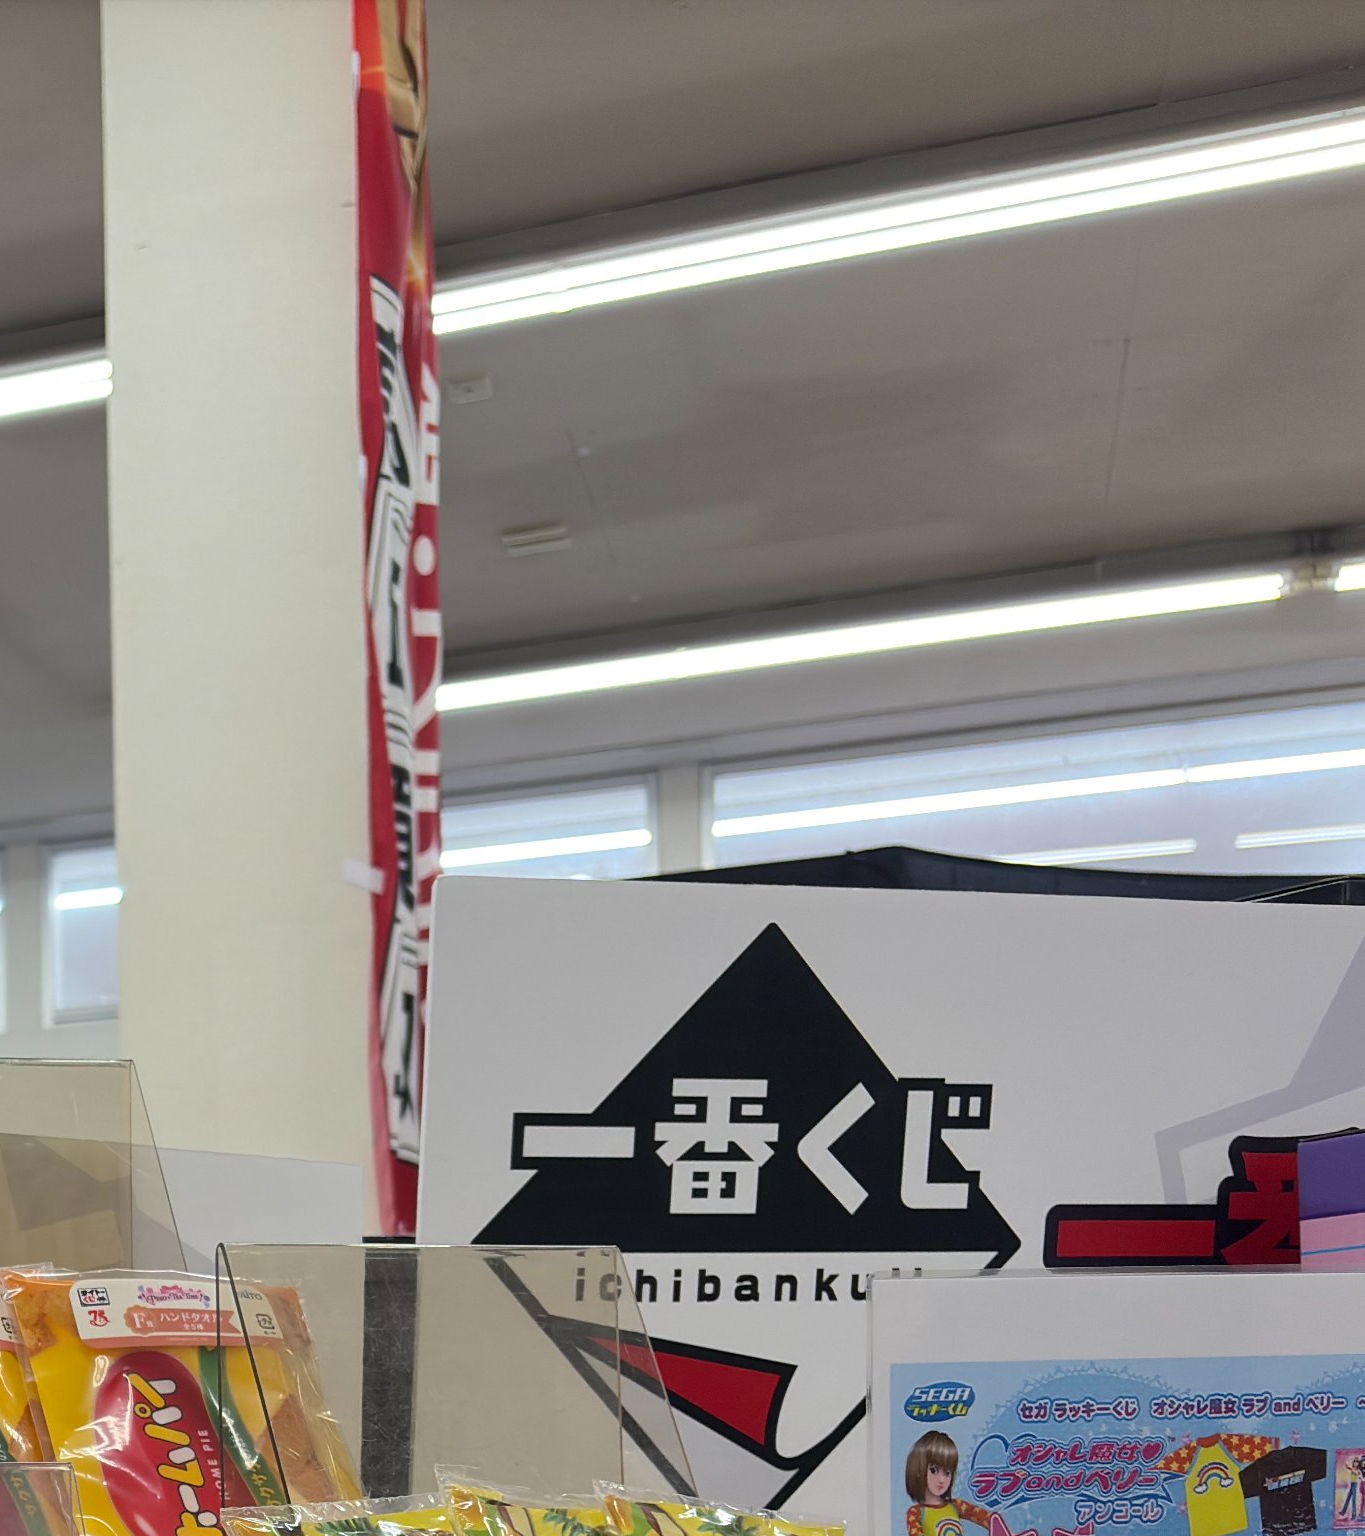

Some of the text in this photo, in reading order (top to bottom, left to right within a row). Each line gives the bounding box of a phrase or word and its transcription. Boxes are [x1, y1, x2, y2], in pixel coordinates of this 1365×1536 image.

[519, 1076, 993, 1217] 一番くじ
[913, 1387, 972, 1402] SEGA
[1019, 1396, 1347, 1420] セガ ラッキーくじ オシャレ魔女 ラブ and ベリー
[1009, 1440, 1137, 1467] オシャレ魔女
[1076, 1501, 1165, 1523] アンコール
